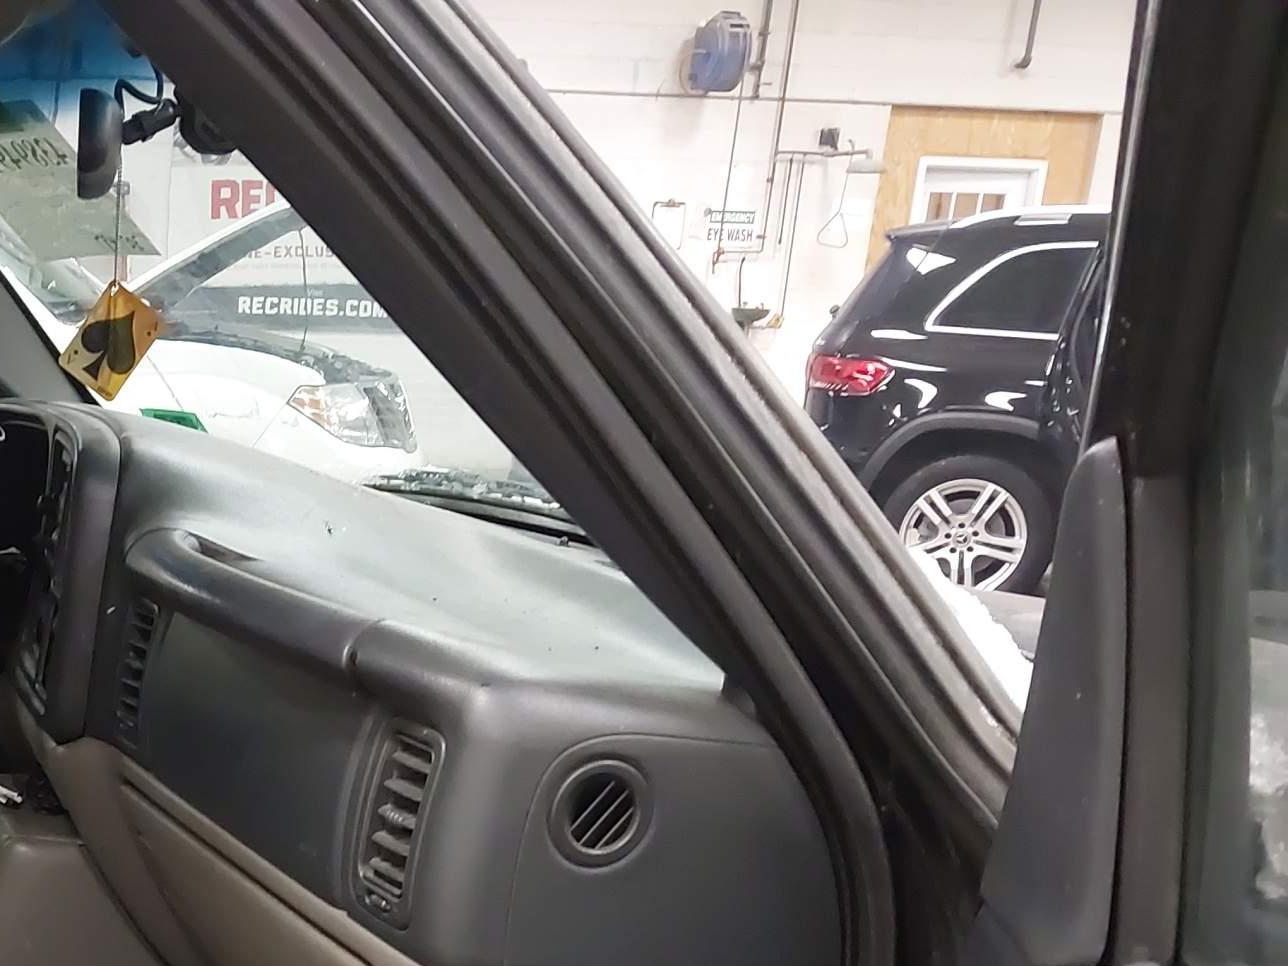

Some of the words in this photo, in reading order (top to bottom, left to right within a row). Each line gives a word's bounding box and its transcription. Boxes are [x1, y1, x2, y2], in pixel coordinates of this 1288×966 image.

[707, 228, 724, 241] EYE
[727, 229, 753, 242] WASH
[238, 296, 389, 319] RECRIDES.COM
